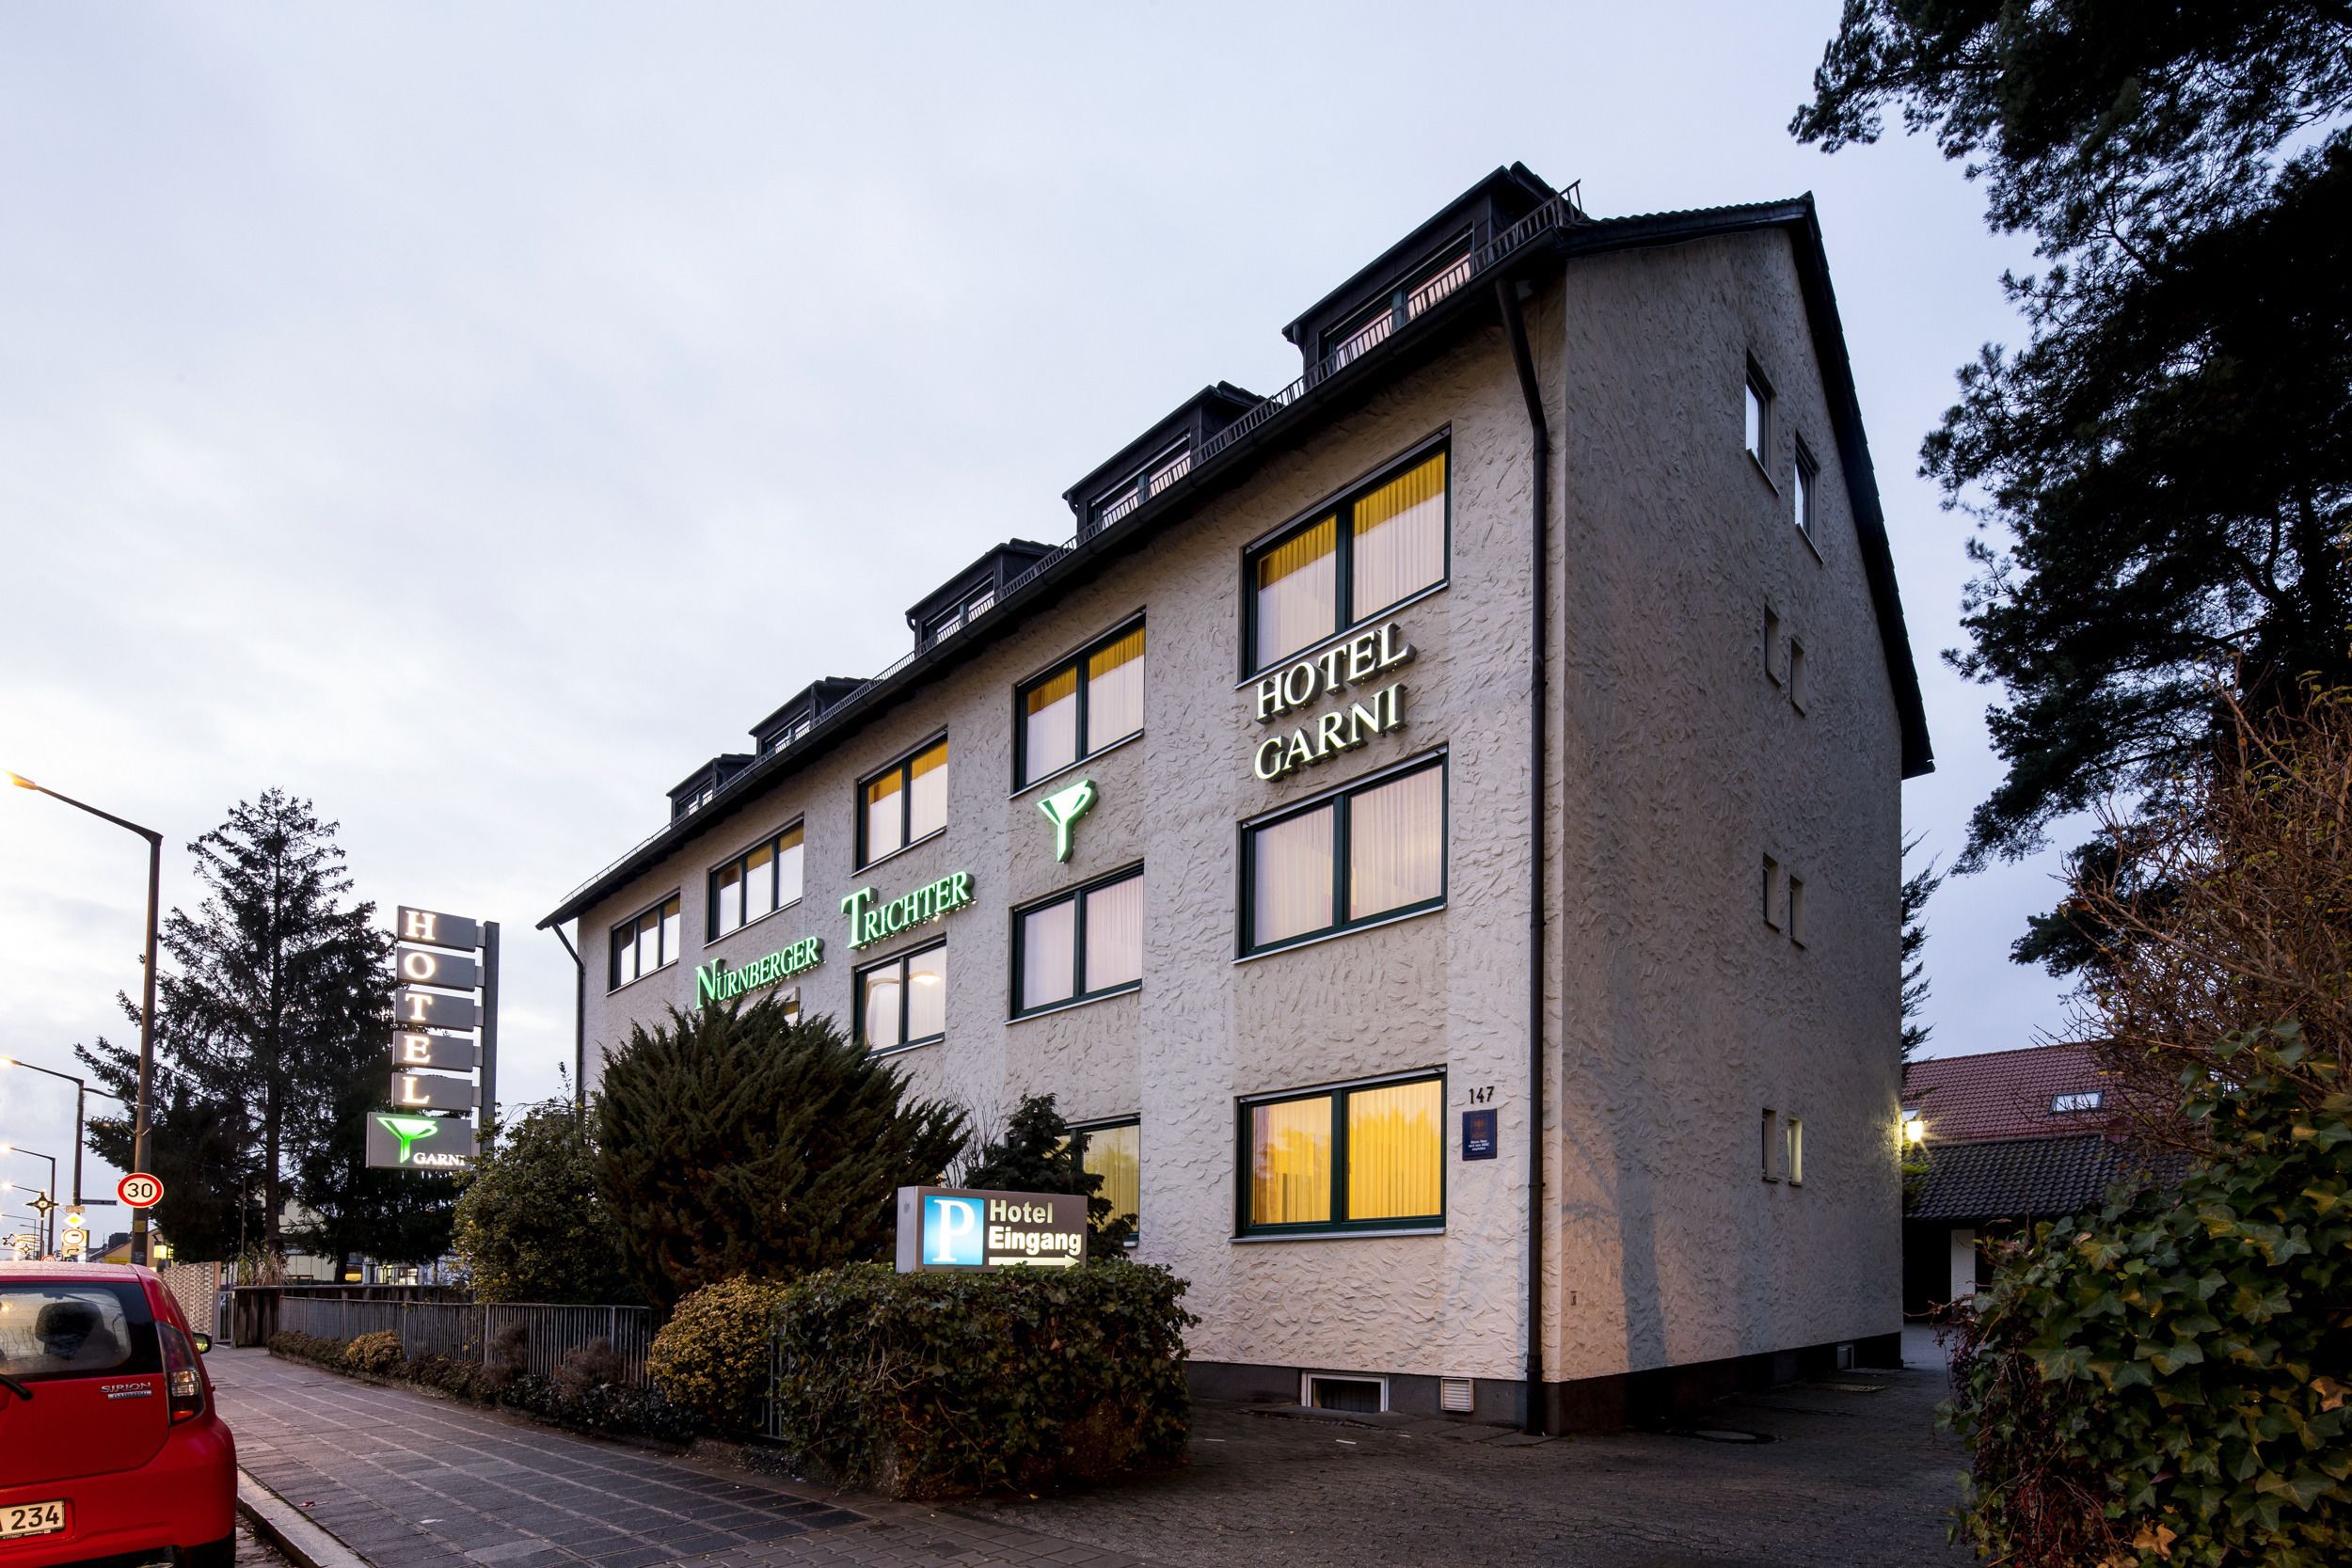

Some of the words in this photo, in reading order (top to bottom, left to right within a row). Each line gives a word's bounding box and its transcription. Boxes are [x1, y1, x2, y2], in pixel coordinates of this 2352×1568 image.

[1255, 622, 1414, 722] HOTEL
[1254, 682, 1406, 781] GARNI
[694, 936, 821, 1010] NÜRNBERGER
[840, 871, 972, 949] TRICHTER
[403, 910, 437, 1105] HOTEL
[1469, 1085, 1495, 1104] 147
[413, 1152, 466, 1165] GARNI
[127, 1182, 153, 1197] 30
[990, 1199, 1053, 1224] Hotel
[932, 1198, 976, 1262] P
[988, 1226, 1082, 1256] Eingang
[101, 1382, 151, 1393] SIRION
[11, 1505, 59, 1530] 234
